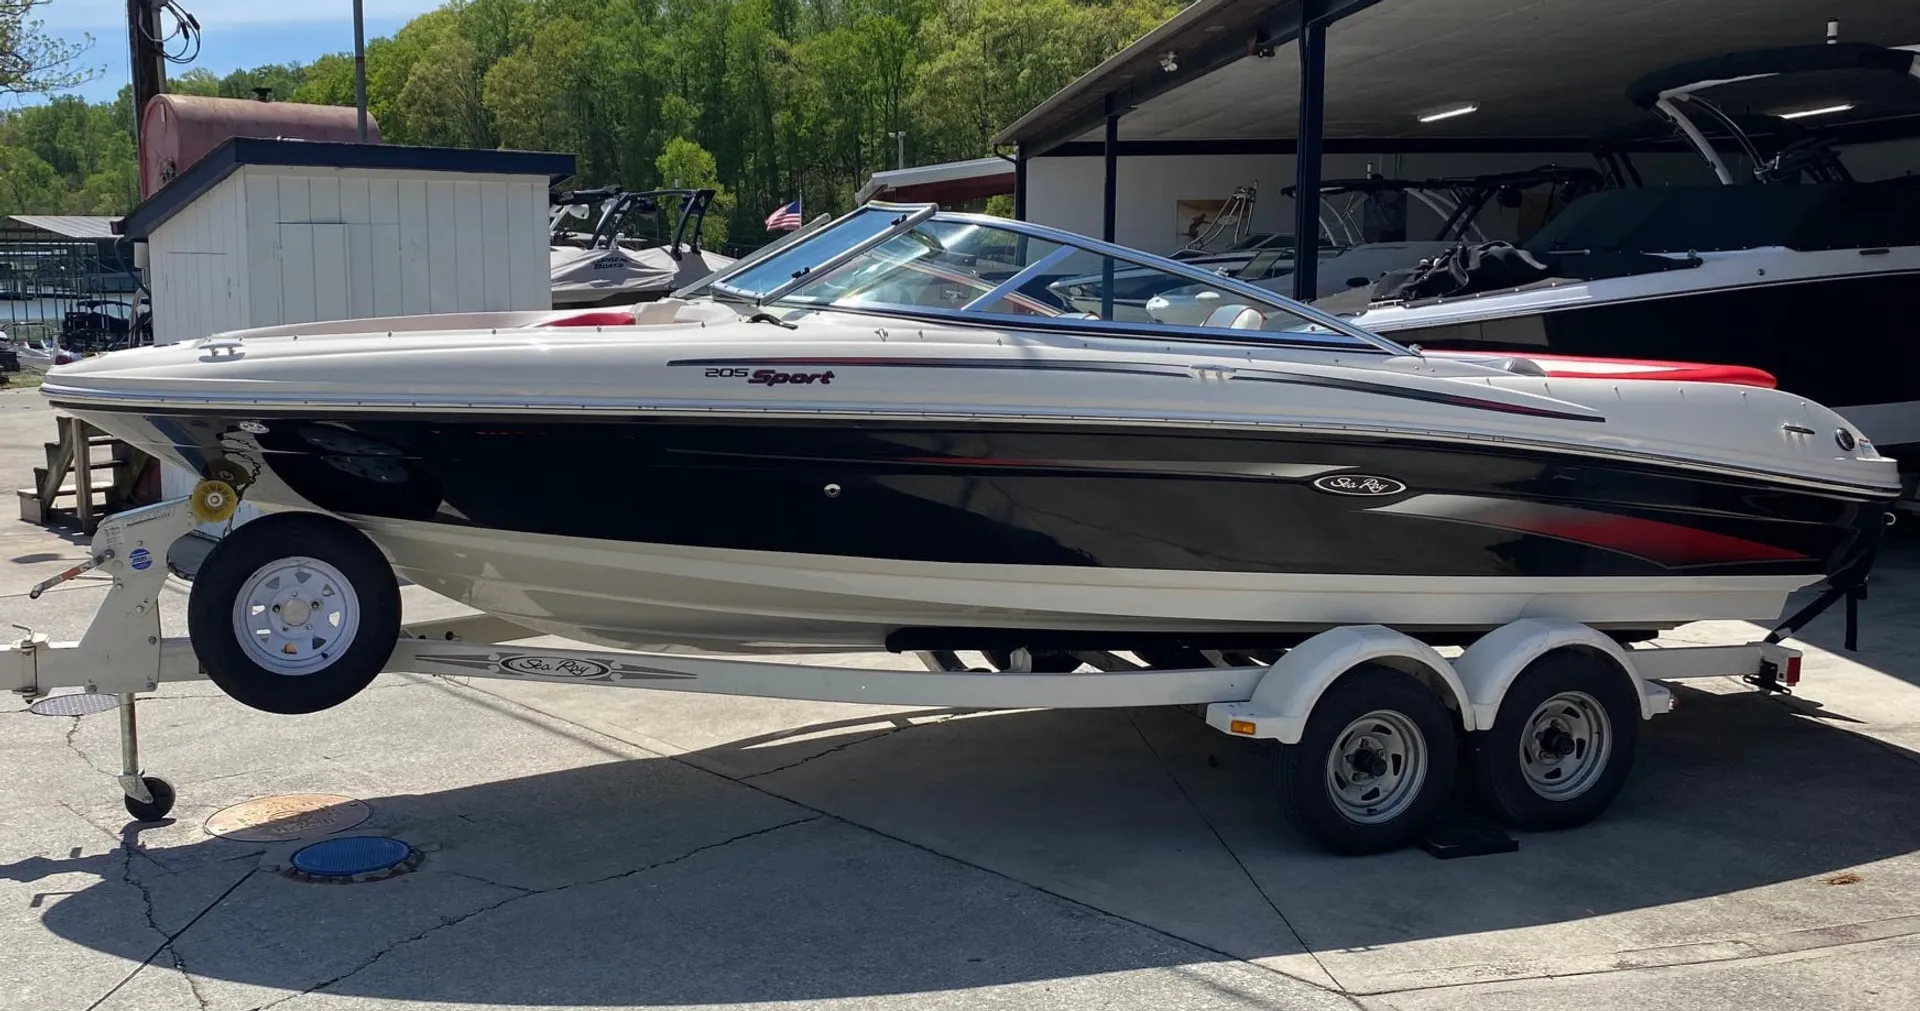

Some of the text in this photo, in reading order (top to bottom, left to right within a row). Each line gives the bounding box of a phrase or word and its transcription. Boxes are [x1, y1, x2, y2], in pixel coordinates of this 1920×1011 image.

[705, 368, 835, 386] 205 Sport
[1330, 477, 1388, 493] Sea Ray
[519, 659, 590, 676] Sea Ray
